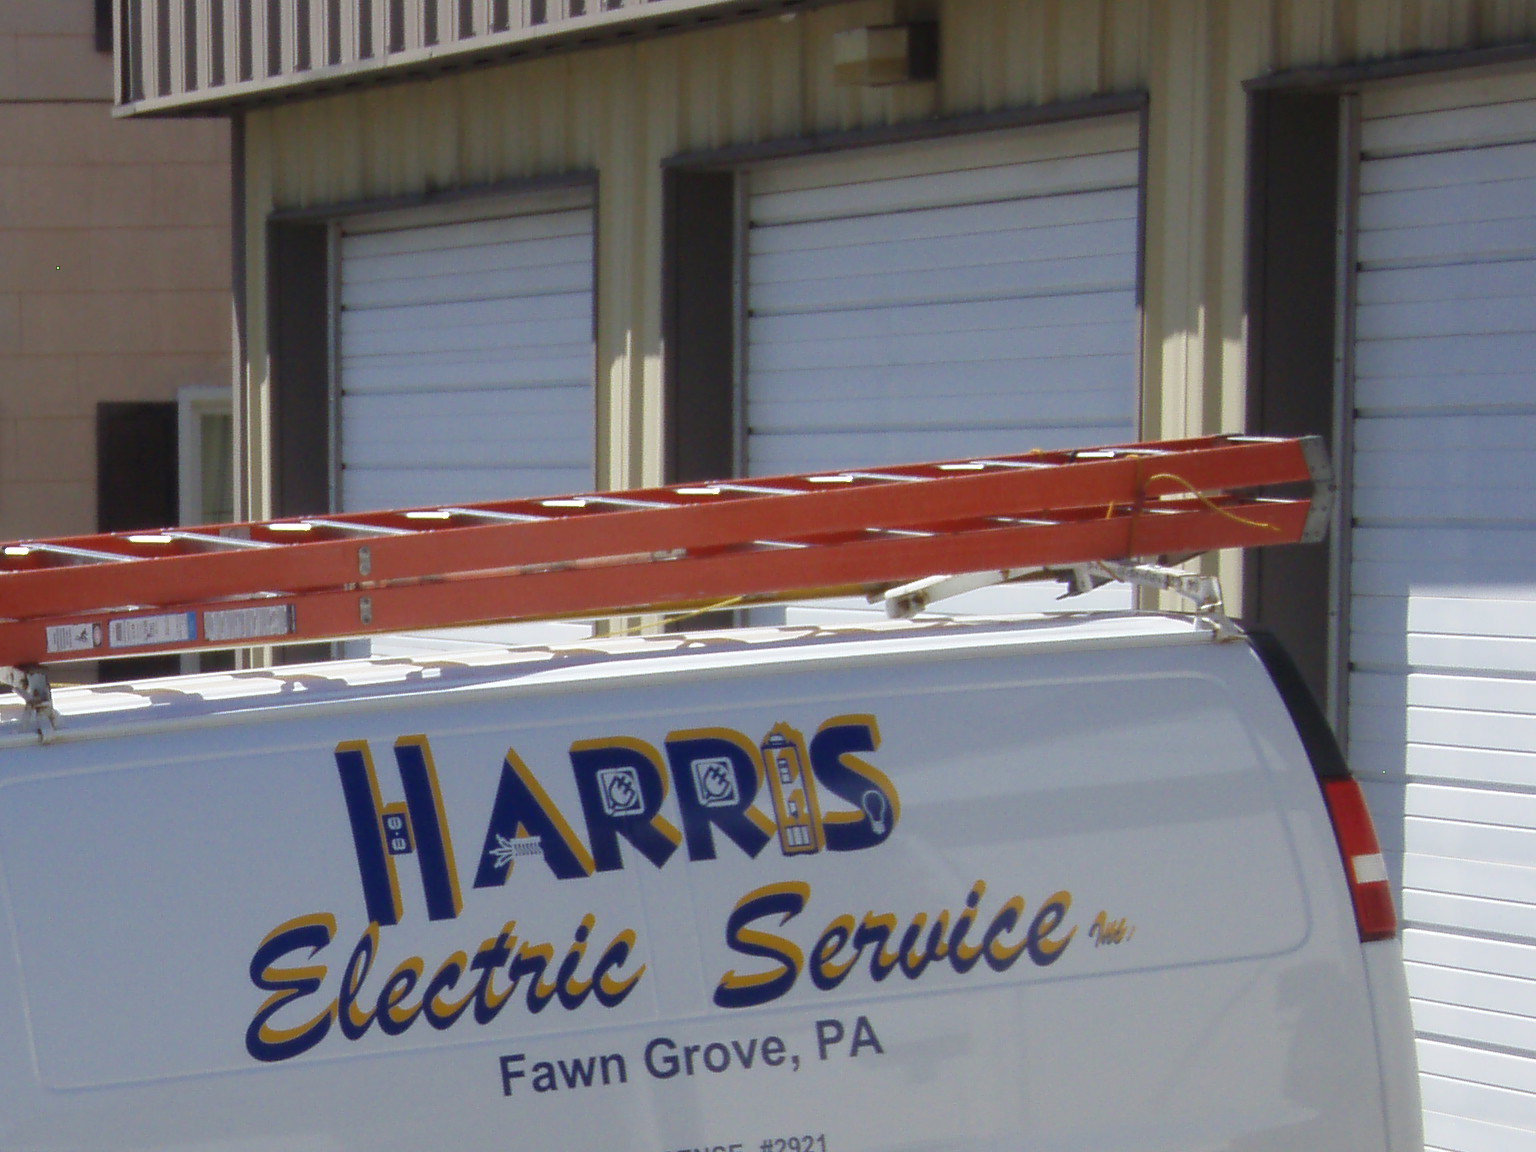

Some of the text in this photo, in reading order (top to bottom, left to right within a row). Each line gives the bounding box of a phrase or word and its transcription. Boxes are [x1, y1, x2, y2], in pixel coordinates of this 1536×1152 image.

[334, 713, 900, 925] HARRIS
[245, 912, 647, 1063] Electric
[713, 879, 1077, 1009] Service
[498, 1015, 885, 1098] Fawn Grove, PA
